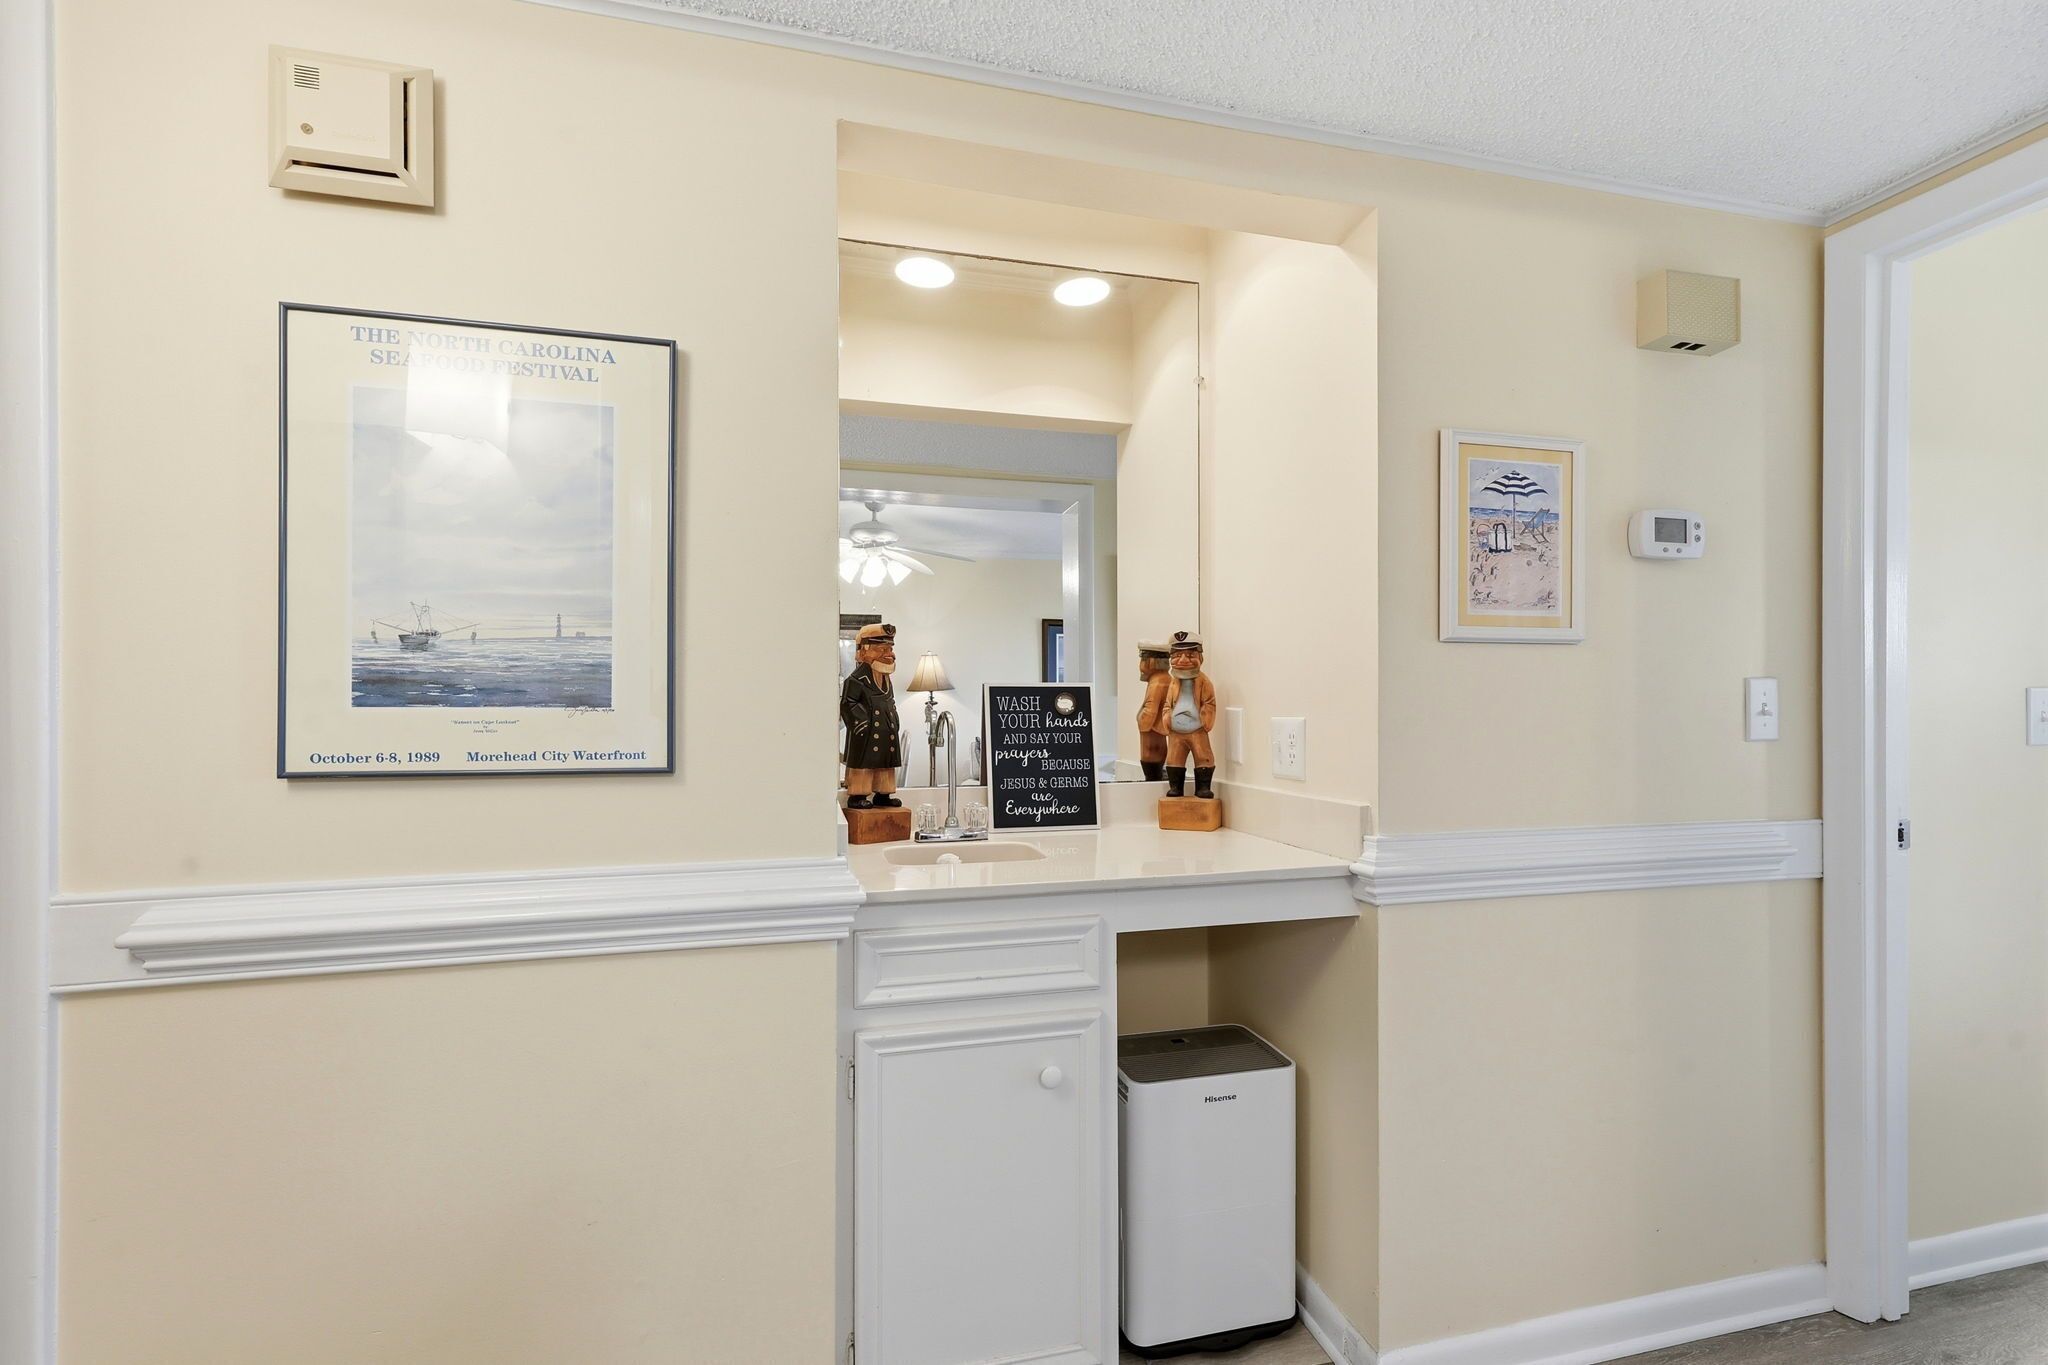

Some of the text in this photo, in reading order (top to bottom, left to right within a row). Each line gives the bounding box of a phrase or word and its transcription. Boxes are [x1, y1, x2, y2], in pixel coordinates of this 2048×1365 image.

[350, 325, 617, 365] THE NORTH CAROLINA
[370, 348, 600, 383] SEAFOOD FESTIVAL
[996, 695, 1041, 711] WASH
[998, 711, 1090, 729] YOUR hands
[1003, 732, 1082, 745] AND SAY YOUR
[309, 751, 441, 765] October 6-8, 1989
[466, 750, 647, 763] Morehead City Waterfront
[995, 748, 1052, 767] prayers
[1041, 758, 1091, 770] BECAUSE
[1000, 776, 1089, 790] JESUS & GERMS
[1031, 792, 1054, 802] are
[1005, 798, 1081, 823] Everywhere
[1204, 1094, 1237, 1104] Hisense
